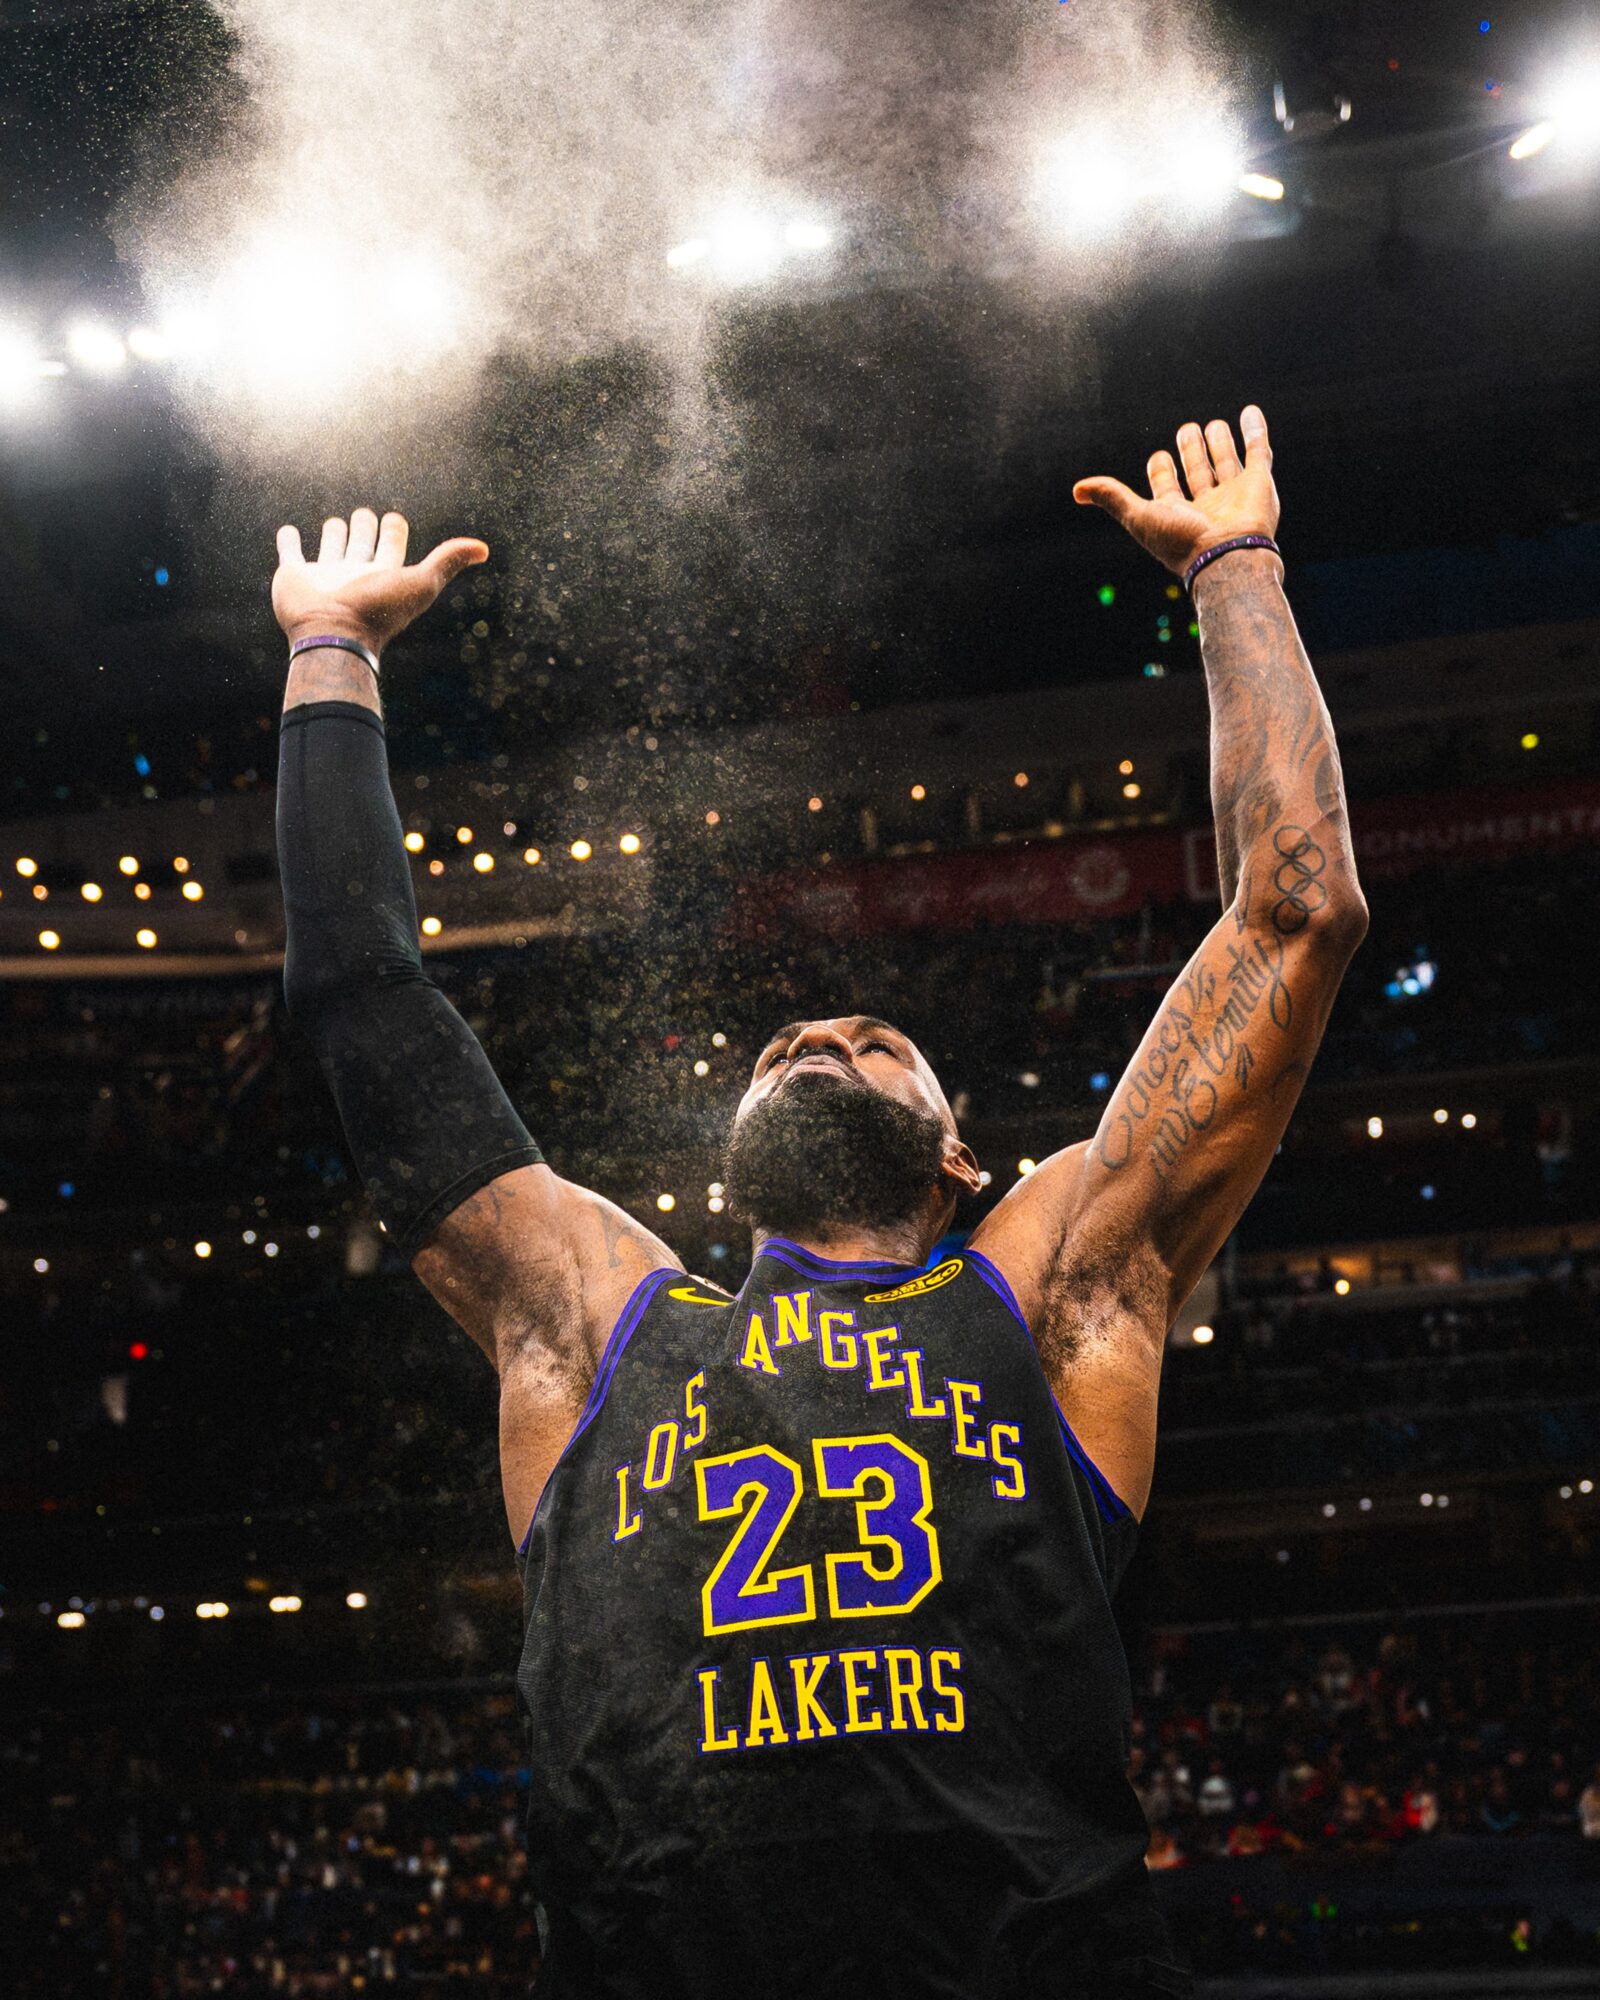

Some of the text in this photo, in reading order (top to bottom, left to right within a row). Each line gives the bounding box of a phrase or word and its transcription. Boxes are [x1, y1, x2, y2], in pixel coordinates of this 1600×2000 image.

[611, 1288, 1029, 1544] LOS ANGELES
[694, 1433, 943, 1637] 23
[695, 1645, 966, 1755] LAKERS
